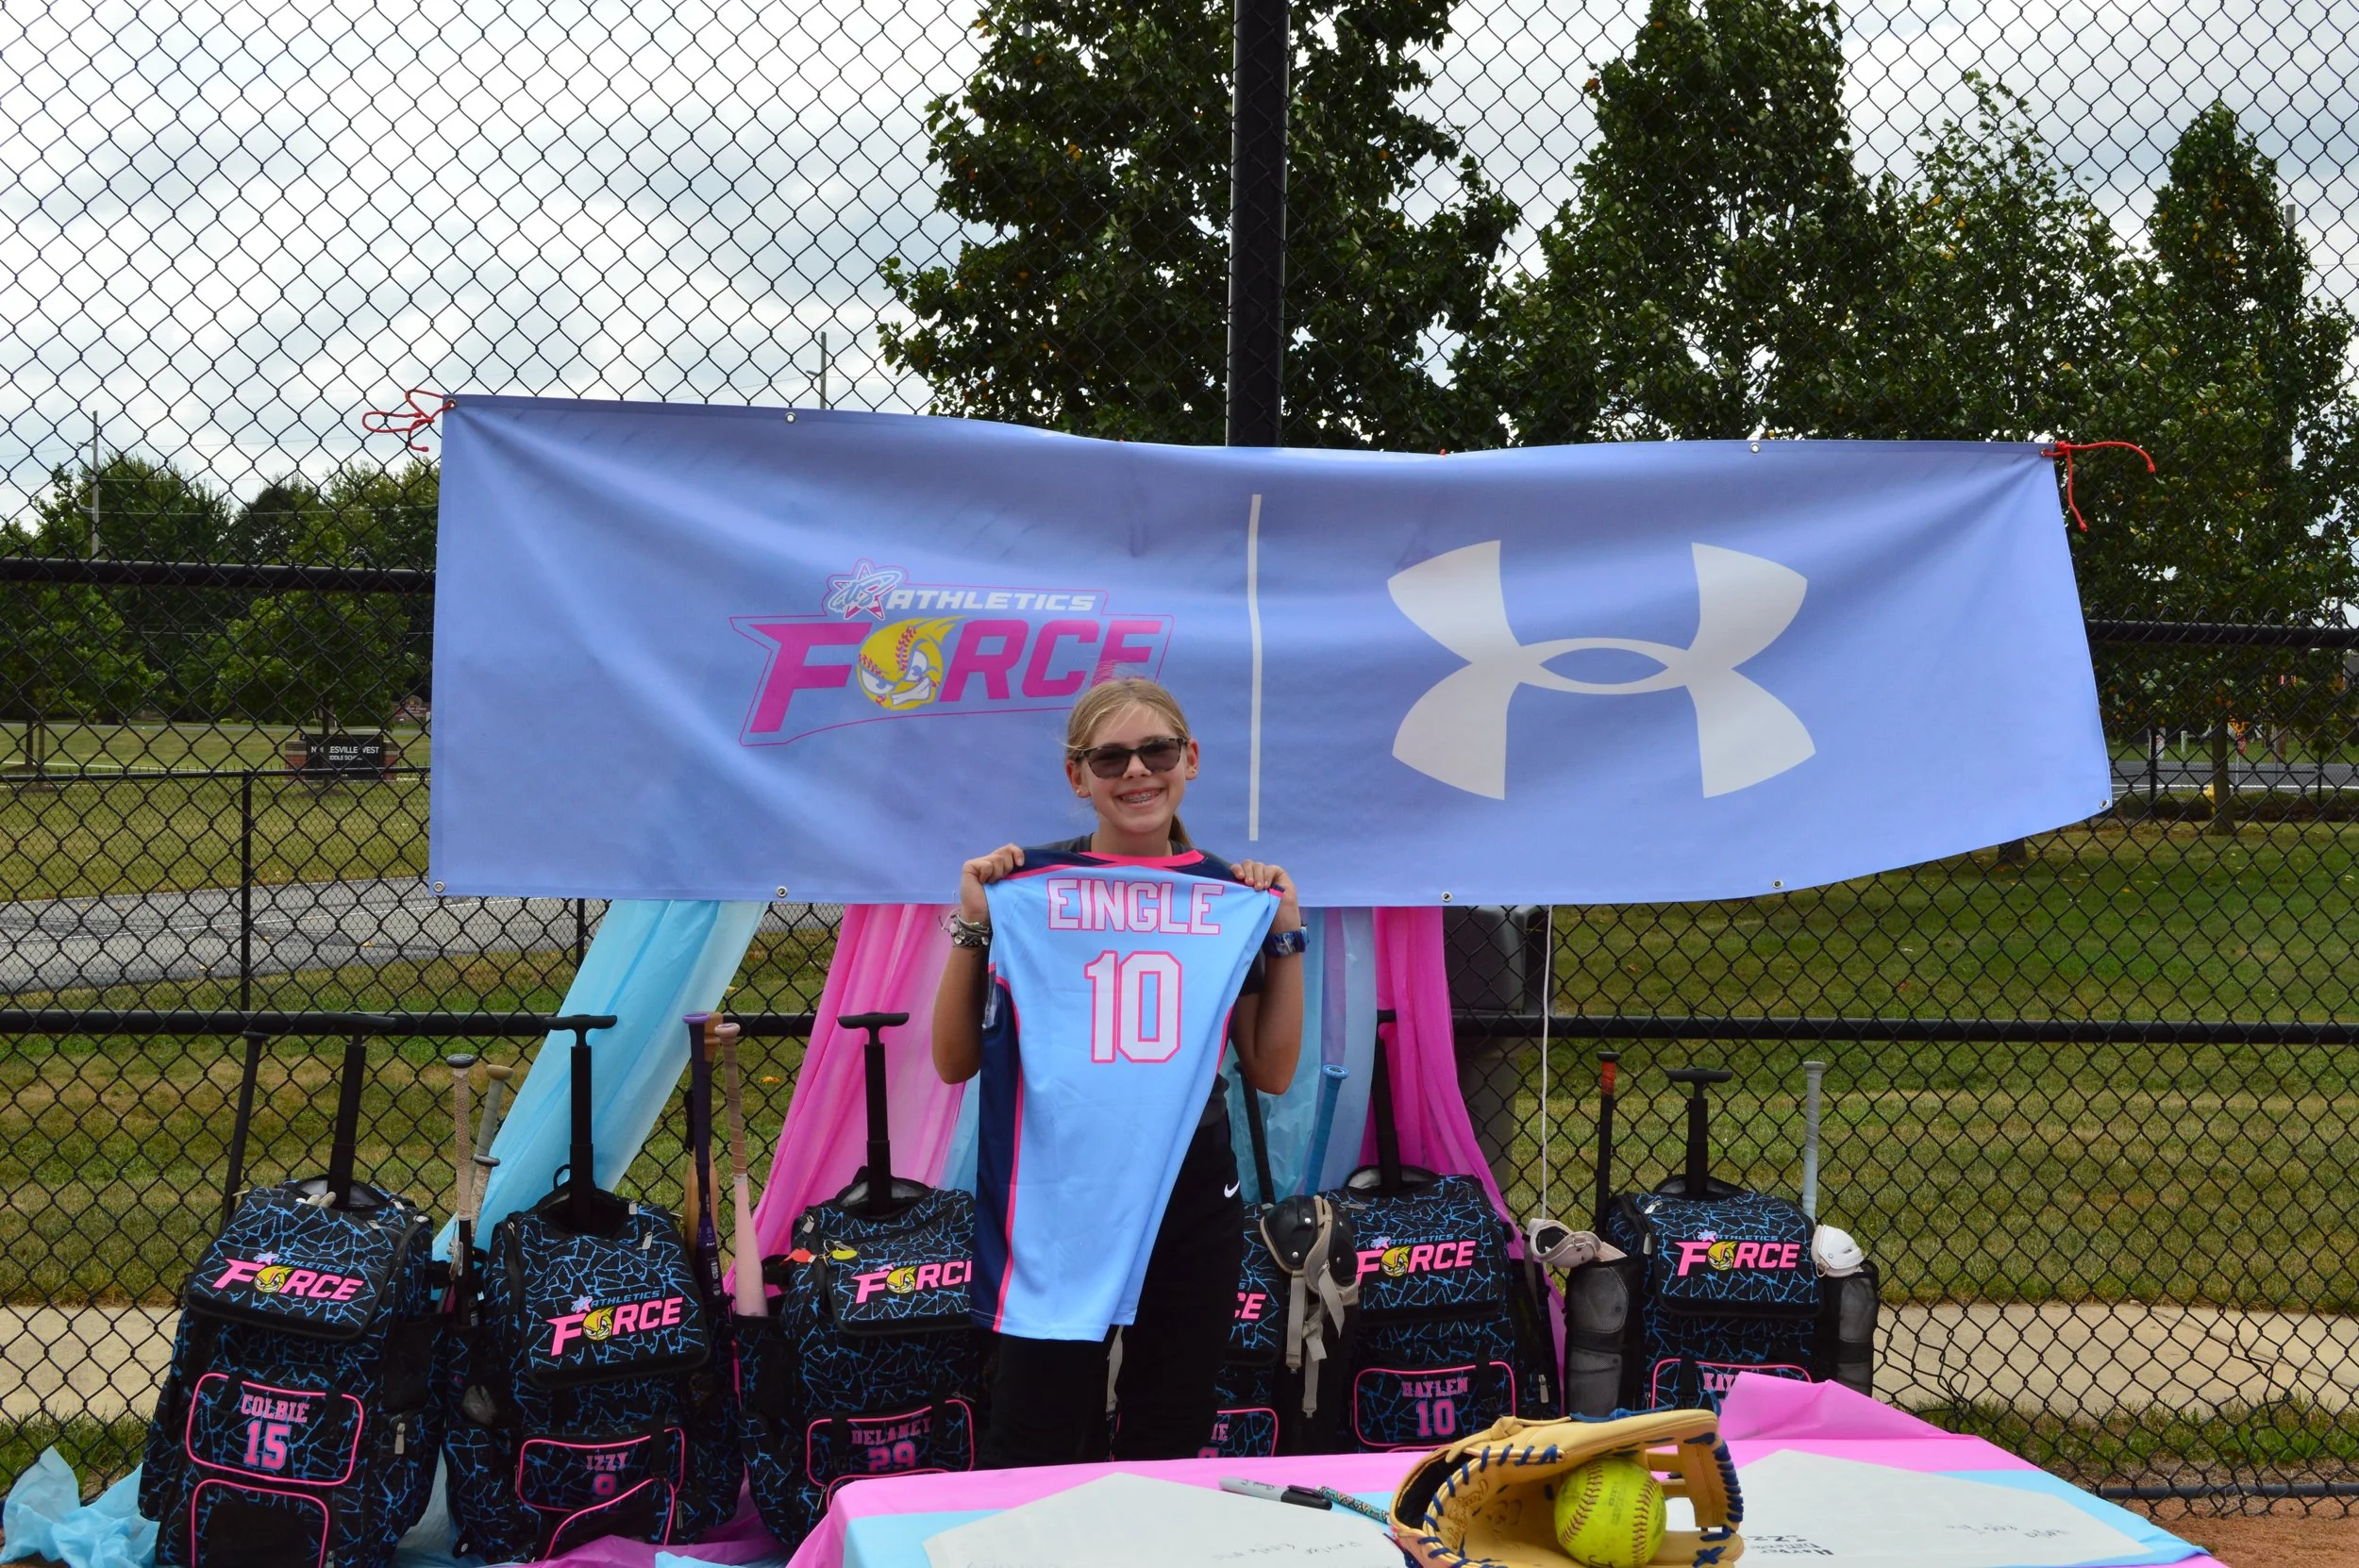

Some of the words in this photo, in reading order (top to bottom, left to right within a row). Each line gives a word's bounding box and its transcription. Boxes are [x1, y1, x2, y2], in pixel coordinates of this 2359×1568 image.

[886, 589, 1097, 612] ATHLETICS
[1046, 877, 1225, 935] EINGLE
[1083, 949, 1183, 1064] 10
[1388, 1232, 1454, 1246] ATHLETICS
[272, 1257, 346, 1274] ATHLETICS
[1356, 1240, 1477, 1287] FORCE
[1674, 1241, 1800, 1277] FORCE
[211, 1258, 364, 1301] FORCE
[590, 1290, 661, 1308] ATHLETICS
[545, 1296, 684, 1357] FORCE
[241, 1394, 310, 1424] COLBIE
[1415, 1398, 1456, 1437] 10
[243, 1420, 293, 1471] 15
[850, 1416, 932, 1446] DELANEY
[586, 1451, 629, 1472] IZZY
[866, 1440, 918, 1473] 29
